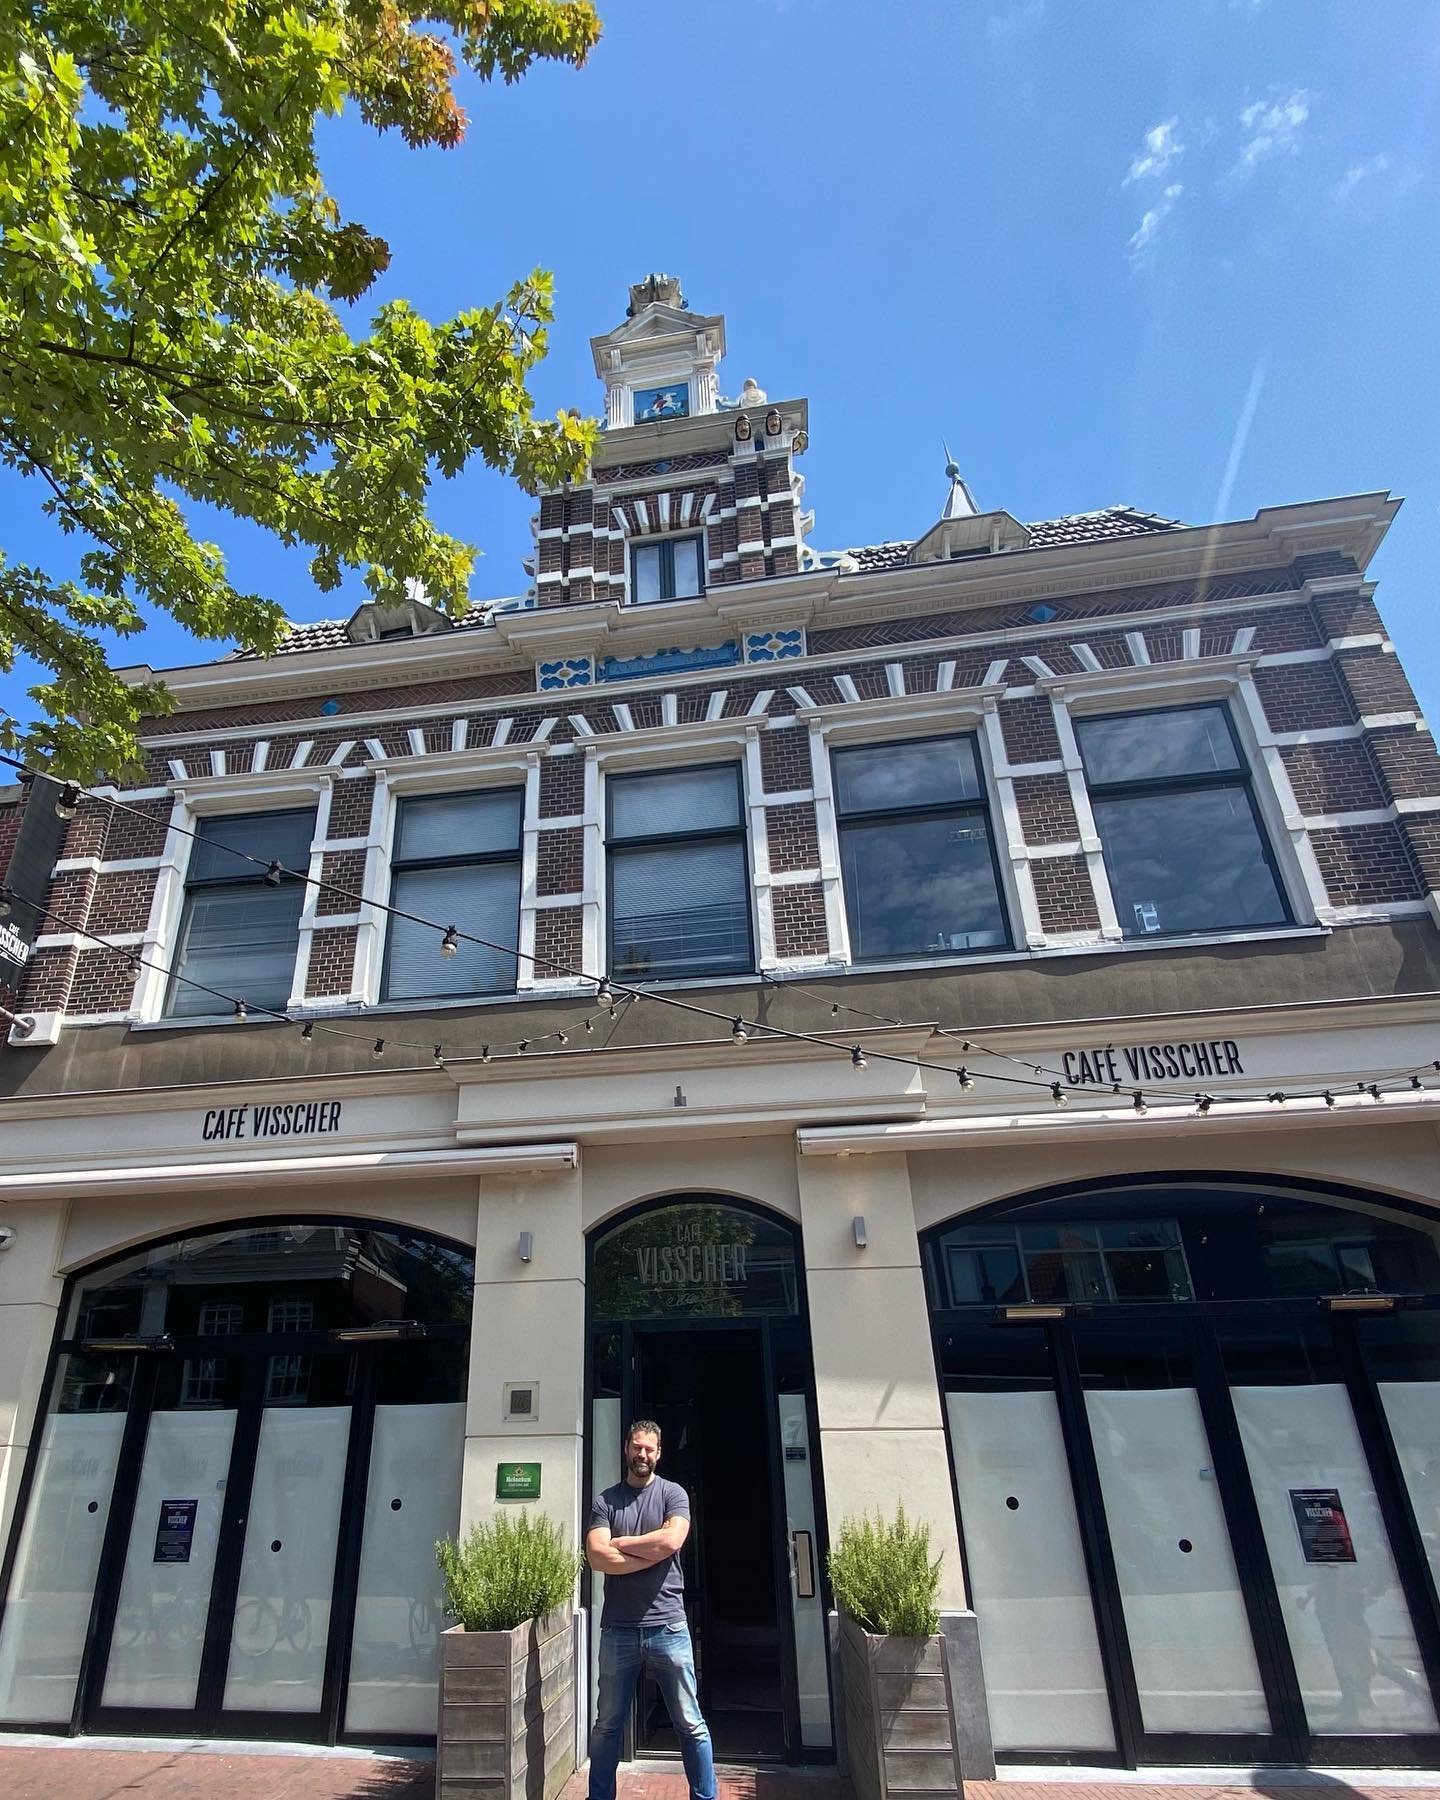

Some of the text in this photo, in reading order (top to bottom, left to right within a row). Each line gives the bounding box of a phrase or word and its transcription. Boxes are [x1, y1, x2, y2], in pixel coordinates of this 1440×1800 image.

[1062, 1040, 1245, 1085] CAFÉ VISSCHER
[202, 1101, 341, 1140] CAFÉ VISSCHER
[635, 1243, 747, 1284] VISSCHER
